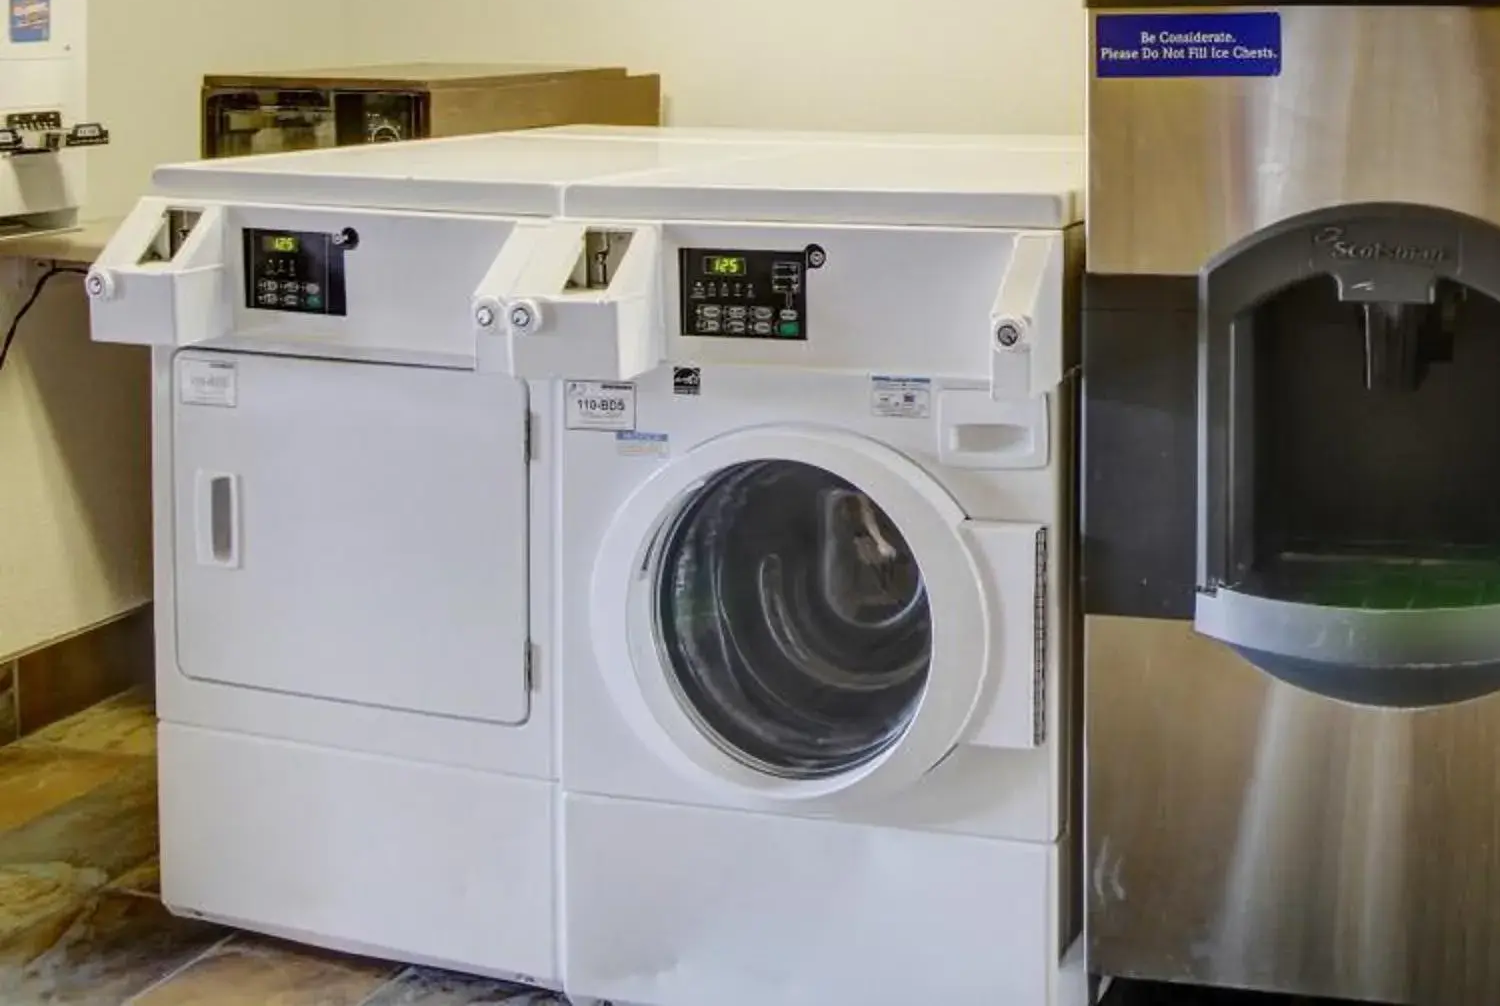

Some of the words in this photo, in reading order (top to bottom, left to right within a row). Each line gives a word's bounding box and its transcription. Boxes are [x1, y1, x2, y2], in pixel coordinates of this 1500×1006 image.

[1140, 32, 1156, 43] Be
[1159, 31, 1236, 43] Considerate.
[1101, 47, 1138, 59] Please
[1142, 47, 1158, 59] Do
[1163, 47, 1184, 59] Not
[1188, 47, 1208, 59] Fill
[1211, 47, 1229, 59] Ice
[1232, 46, 1277, 59] Chests.
[714, 257, 739, 273] 125
